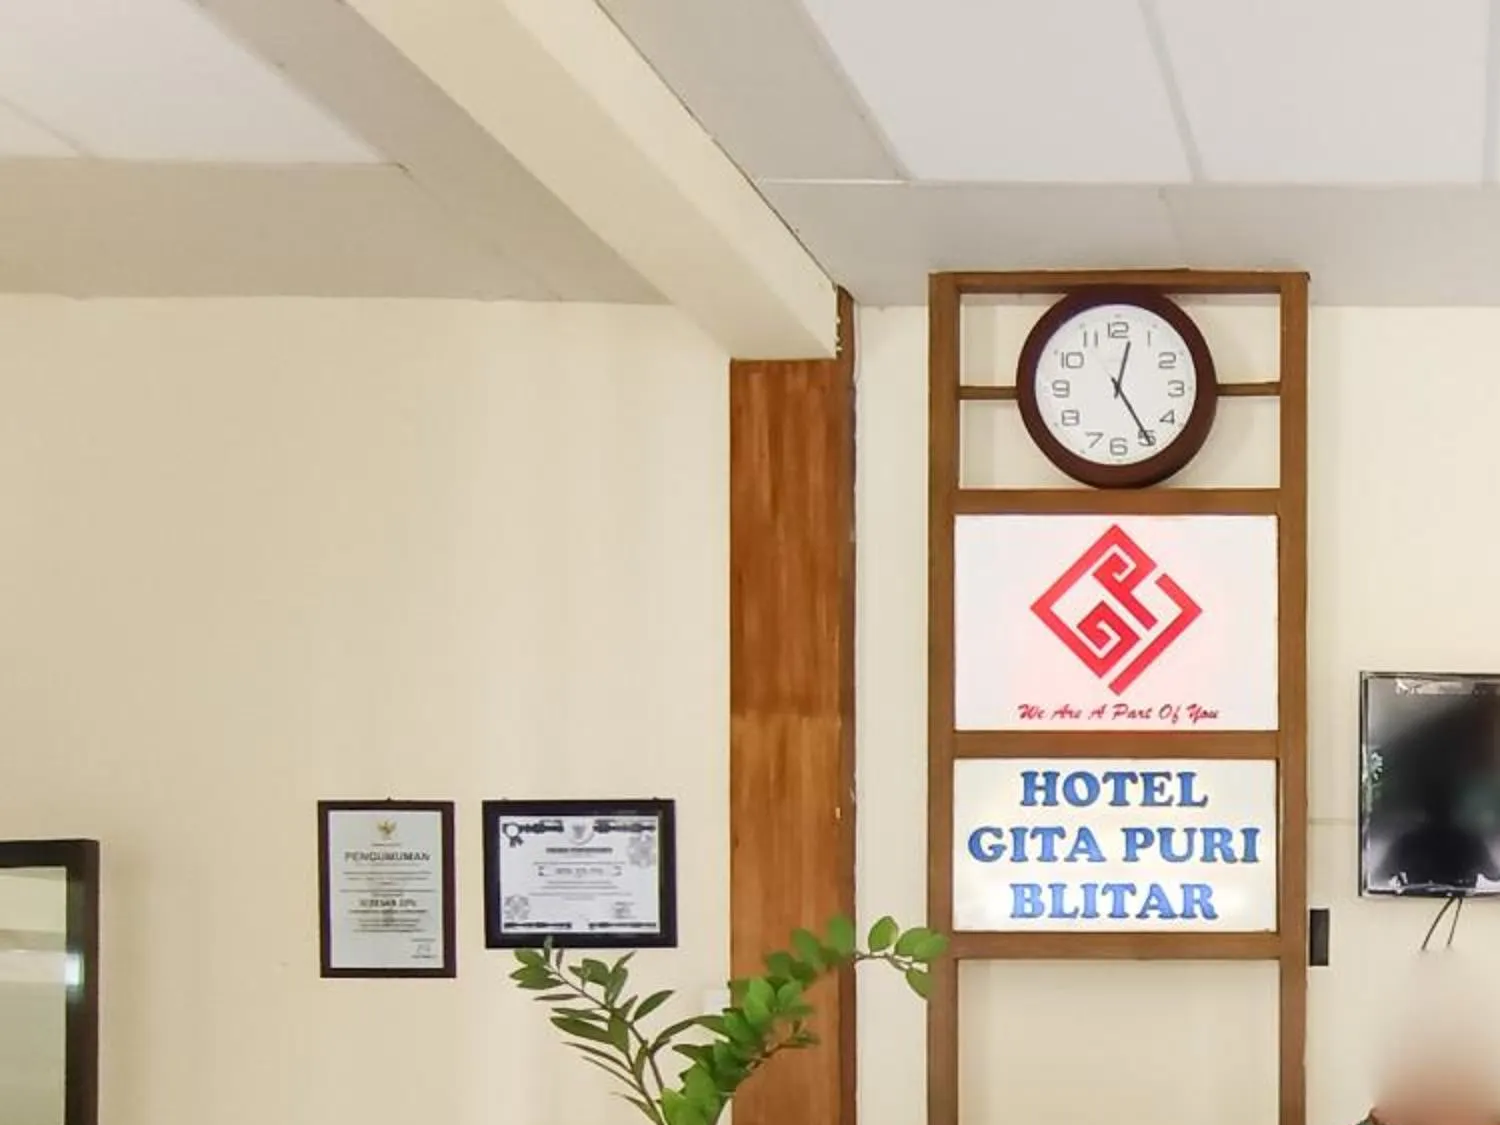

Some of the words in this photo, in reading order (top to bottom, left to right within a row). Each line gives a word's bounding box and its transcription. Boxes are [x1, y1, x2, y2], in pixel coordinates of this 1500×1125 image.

[1083, 330, 1099, 347] 11
[1107, 321, 1130, 339] 12
[1060, 351, 1085, 369] 10
[1157, 351, 1177, 369] 2
[1051, 380, 1071, 398] 9
[1167, 380, 1185, 398] 3
[1061, 409, 1080, 426] 8
[1159, 409, 1176, 424] 4
[1085, 432, 1104, 448] 7
[1109, 438, 1128, 456] 6
[1137, 430, 1157, 447] 5
[1018, 703, 1045, 720] We
[1050, 703, 1081, 720] Are
[1088, 703, 1105, 720] A
[1112, 703, 1152, 720] Part
[1158, 703, 1180, 723] Of
[1186, 703, 1220, 724] You
[1019, 770, 1209, 808] HOTEL
[967, 825, 1107, 864] GITA
[1120, 826, 1261, 864] PURI
[1009, 882, 1219, 920] BLITAR
